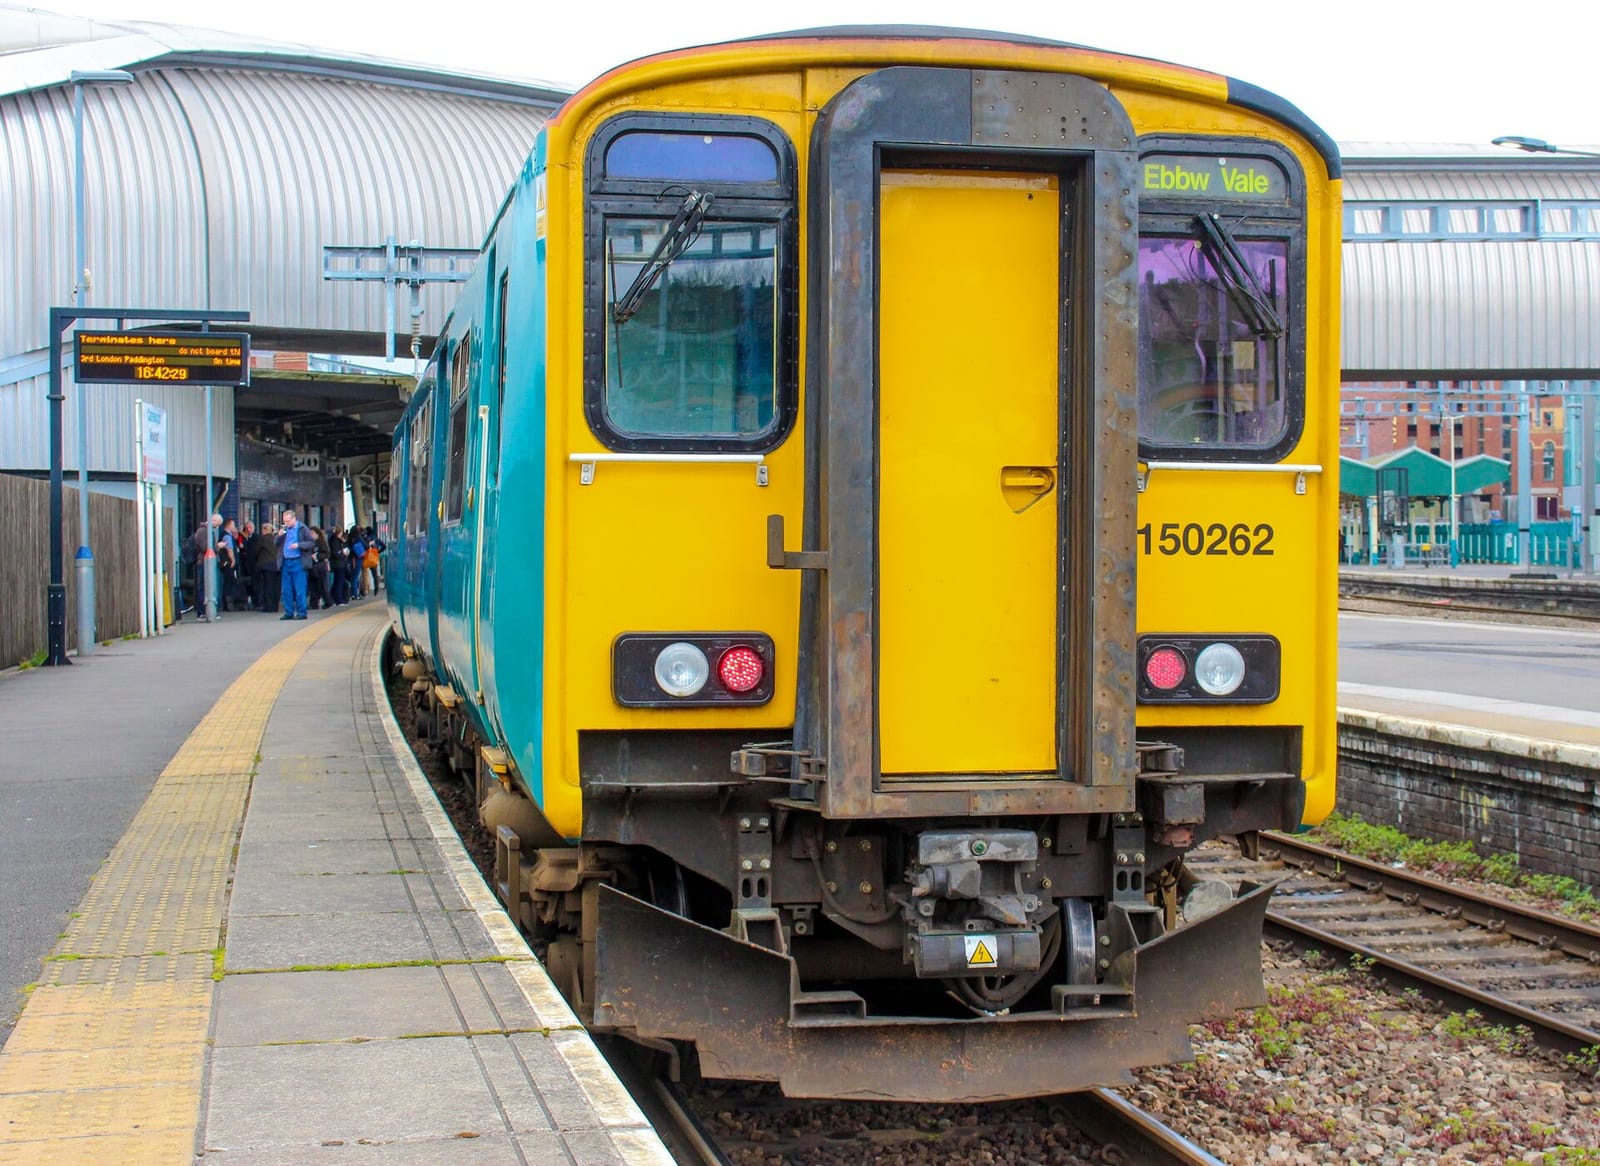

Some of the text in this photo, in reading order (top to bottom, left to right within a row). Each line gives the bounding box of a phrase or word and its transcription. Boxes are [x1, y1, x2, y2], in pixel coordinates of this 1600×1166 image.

[1144, 164, 1269, 193] Ebbw Vale
[80, 334, 177, 345] Terminates here
[178, 347, 188, 355] do
[190, 347, 203, 356] not
[206, 347, 228, 356] board
[96, 354, 122, 363] London
[124, 355, 165, 365] Paddington
[226, 358, 241, 366] time
[137, 366, 187, 380] 16:42:29
[1137, 522, 1275, 556] 150262
